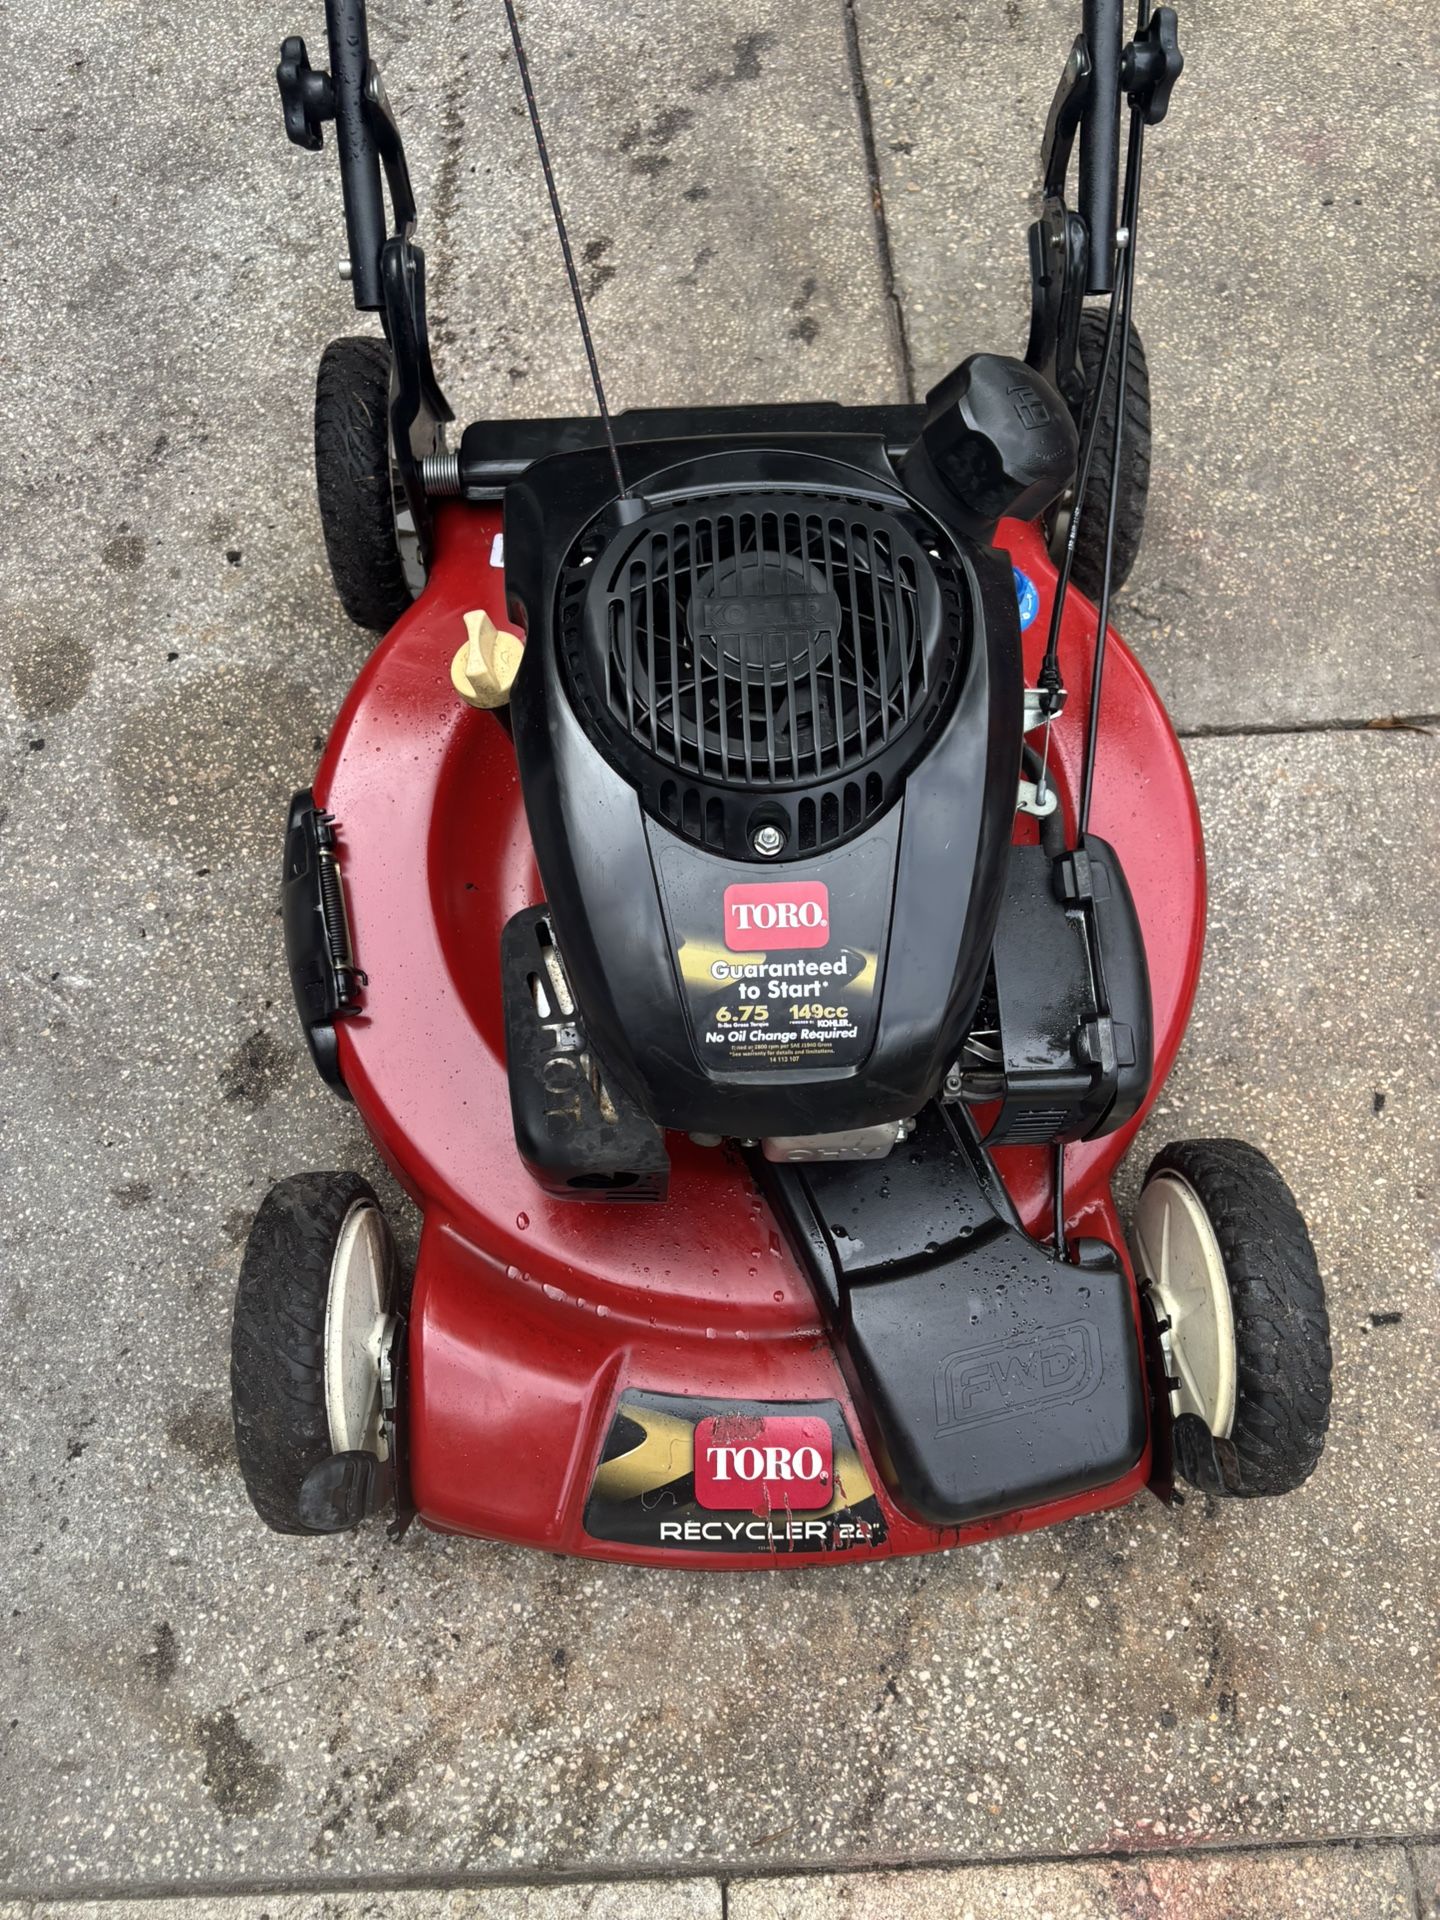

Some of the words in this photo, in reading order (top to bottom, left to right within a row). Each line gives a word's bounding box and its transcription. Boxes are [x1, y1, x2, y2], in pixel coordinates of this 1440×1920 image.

[731, 901, 823, 930] TORO
[711, 955, 848, 980] Guaranteed
[738, 983, 761, 1000] to
[715, 1004, 769, 1022] 6.75
[789, 1003, 849, 1020] 149cc
[705, 1031, 725, 1043] No
[728, 1029, 747, 1042] Oil
[749, 1028, 798, 1044] Change
[800, 1025, 858, 1042] Required
[961, 1344, 1077, 1410] FWD
[706, 1446, 823, 1481] TORO
[659, 1520, 828, 1541] RECYCLER
